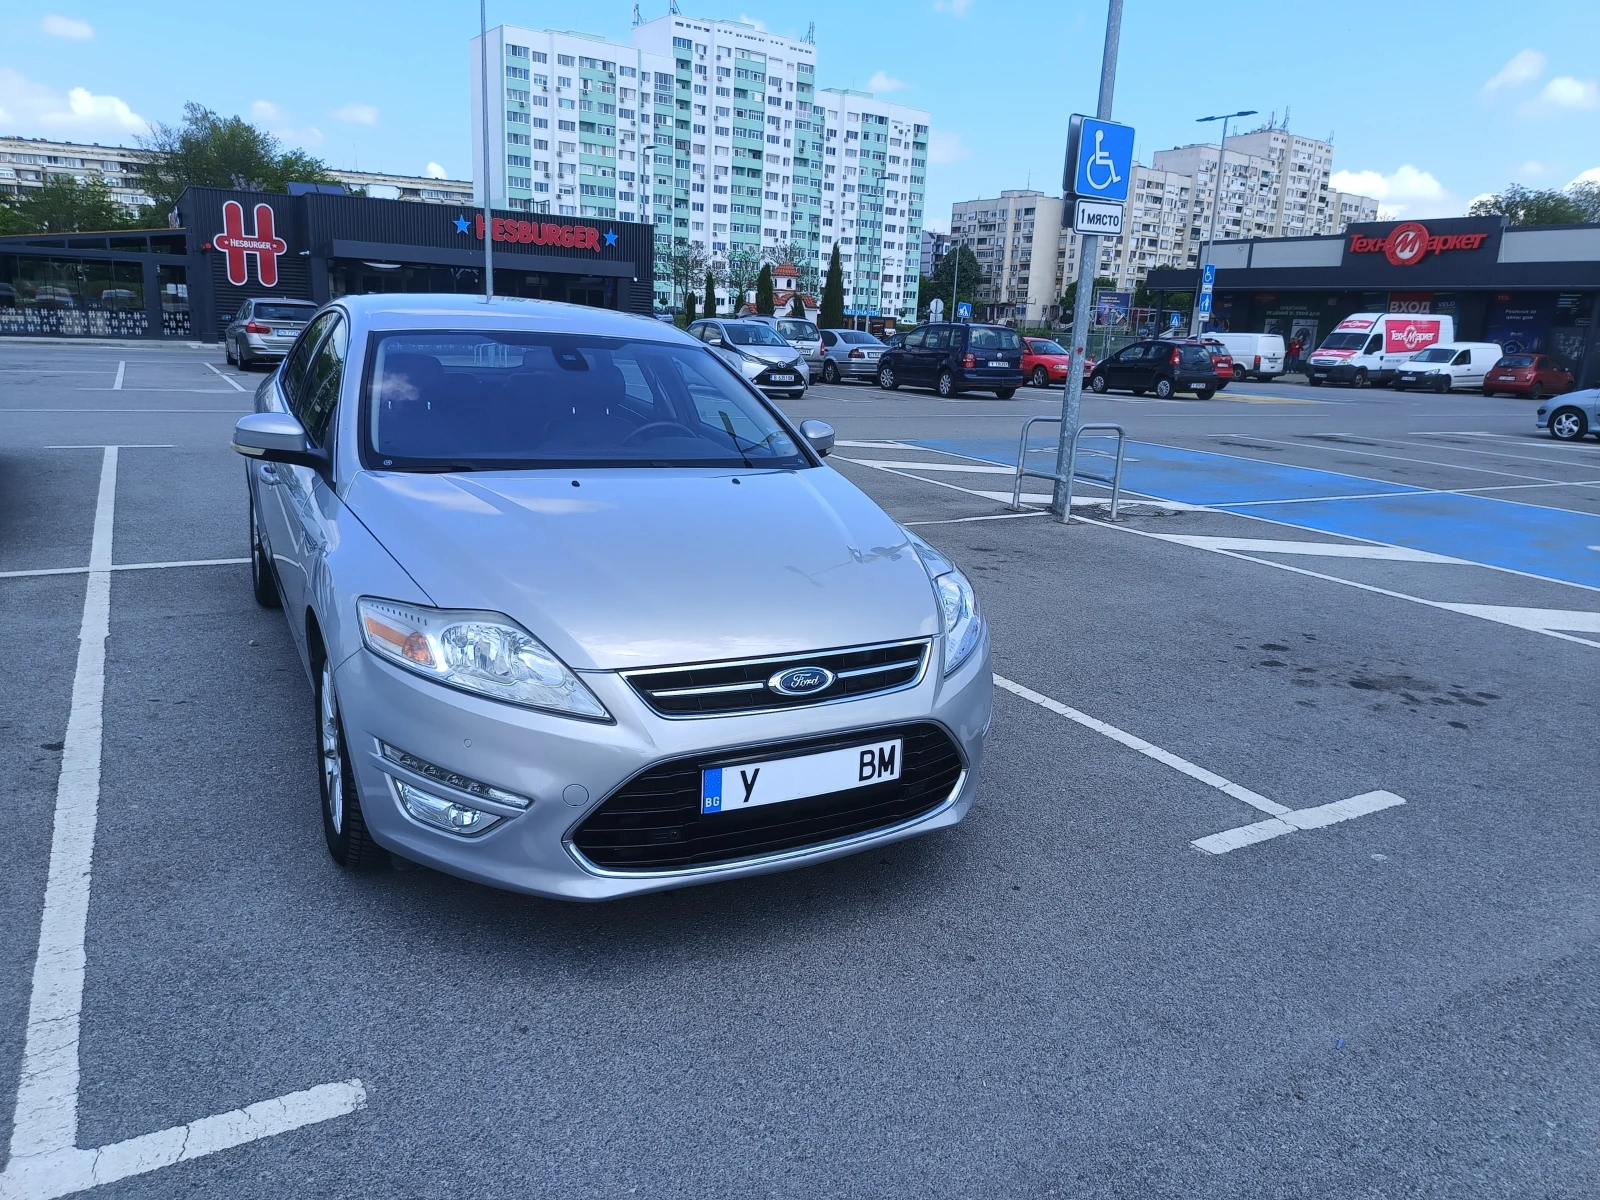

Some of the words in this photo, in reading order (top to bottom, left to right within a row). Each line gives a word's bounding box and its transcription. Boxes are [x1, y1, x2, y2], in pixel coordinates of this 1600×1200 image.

[1081, 208, 1086, 225] 1
[1087, 212, 1120, 227] МЯСТО
[475, 213, 601, 253] HESBURGER
[229, 238, 273, 251] HESBURGER
[1389, 301, 1431, 315] ВХОД
[790, 672, 820, 688] Ford
[705, 796, 720, 808] BG
[859, 745, 896, 782] BM
